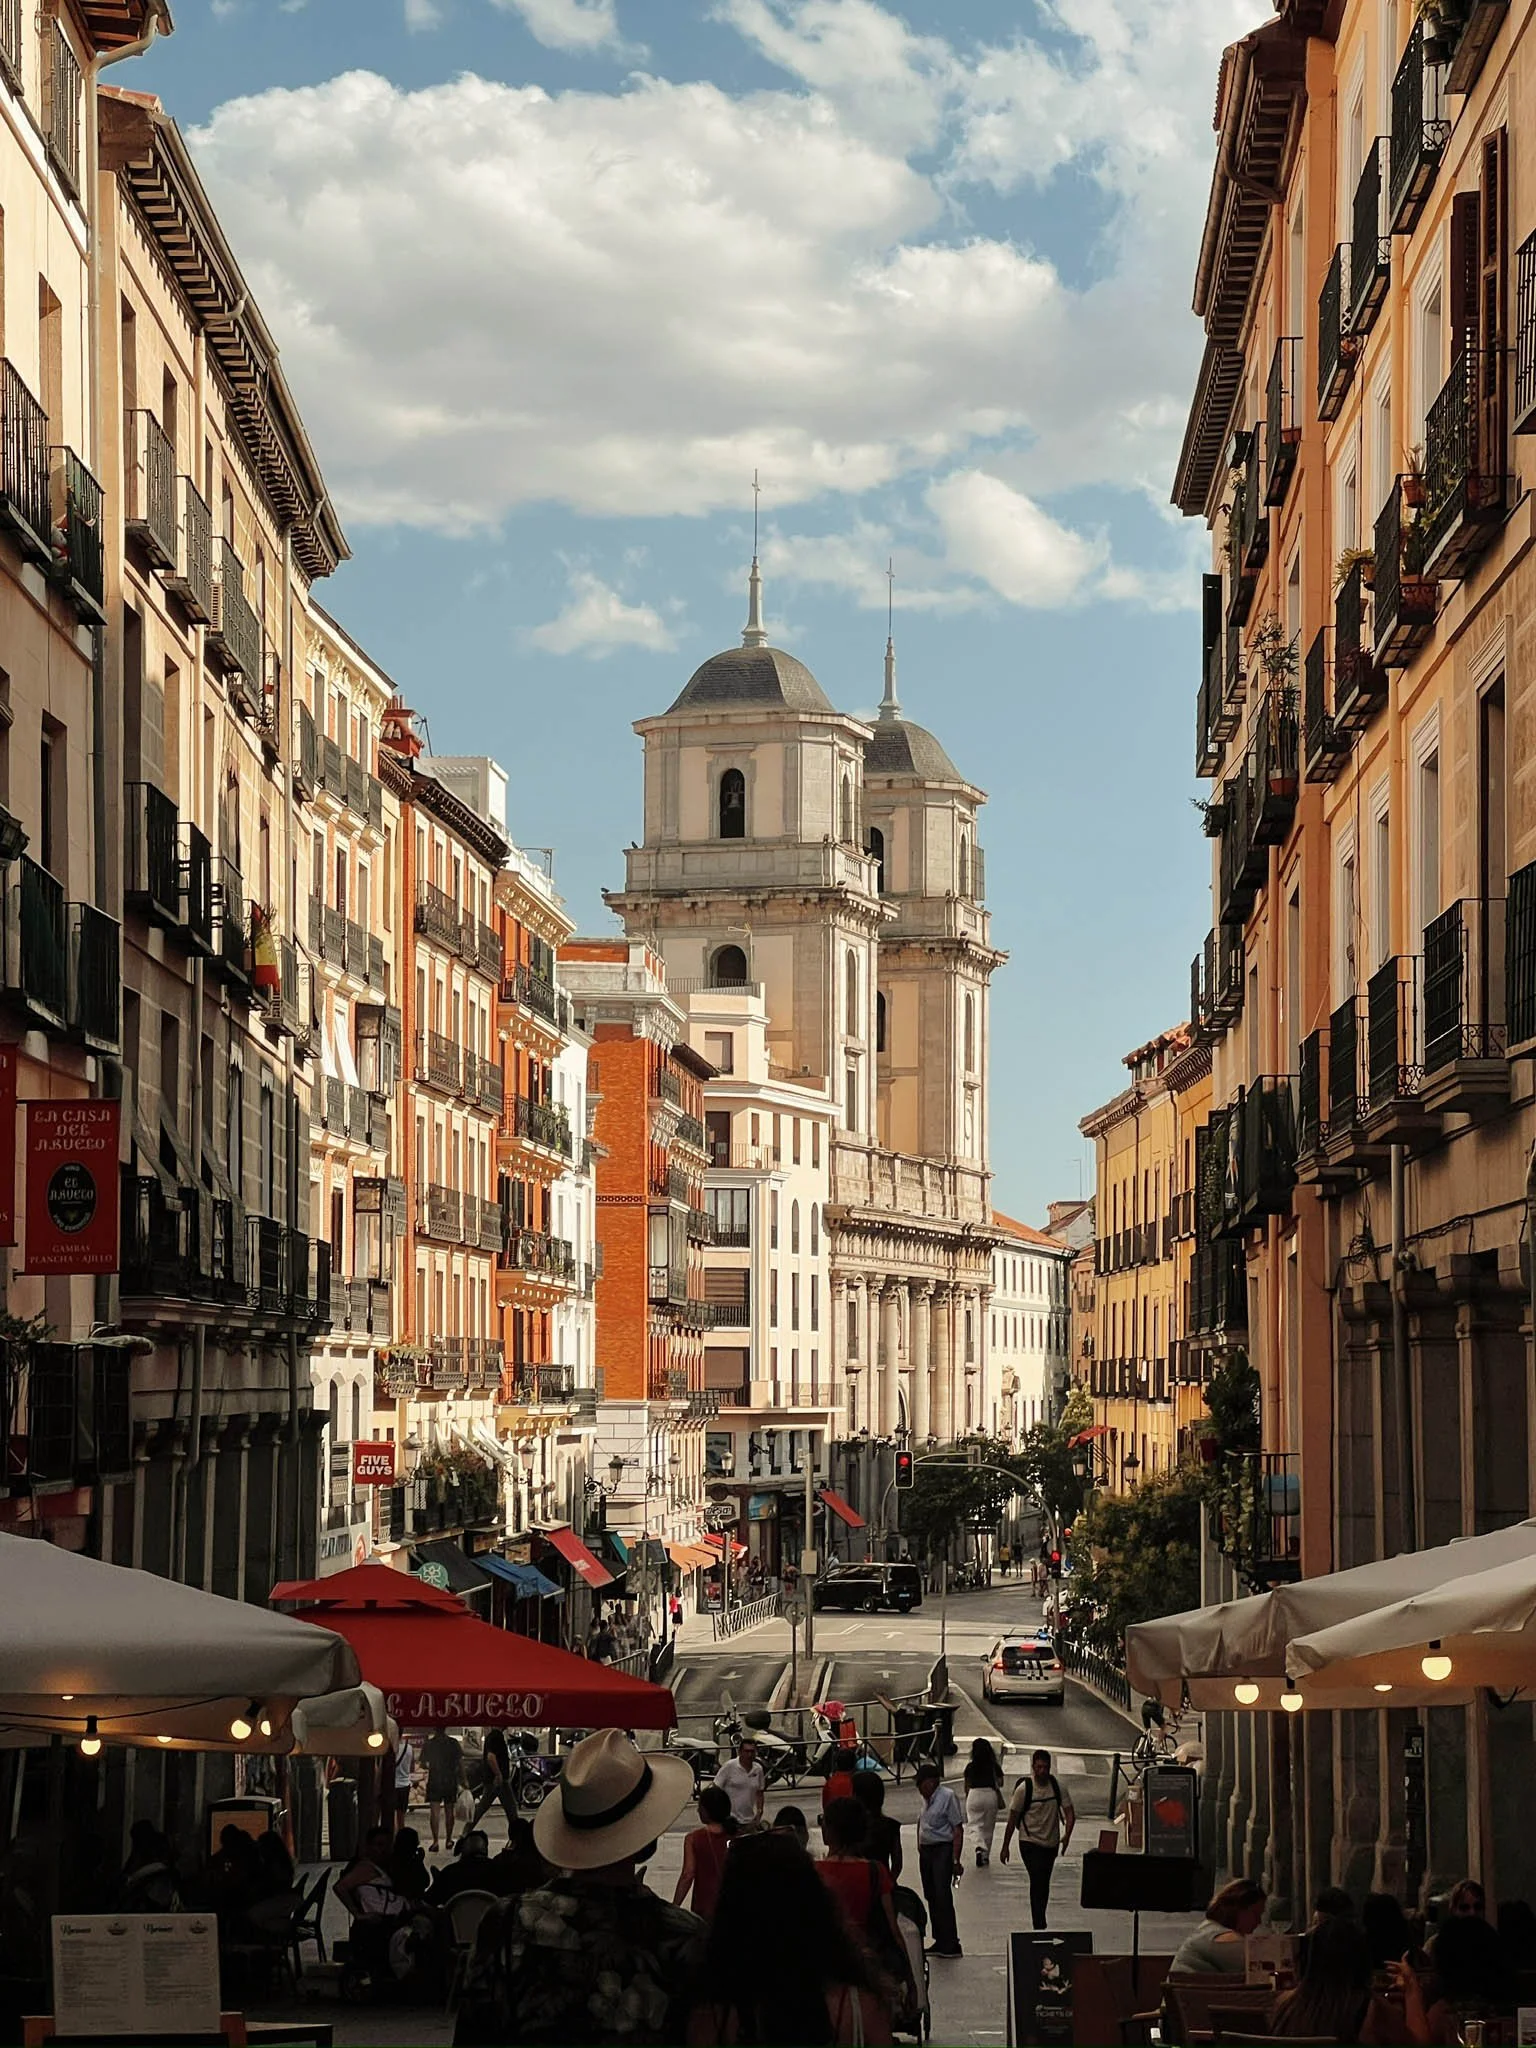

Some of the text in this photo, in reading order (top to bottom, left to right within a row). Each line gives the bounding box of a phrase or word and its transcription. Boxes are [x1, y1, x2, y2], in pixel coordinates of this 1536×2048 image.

[62, 1109, 110, 1122] CASA
[55, 1124, 90, 1137] DEL
[34, 1138, 105, 1151] ABUELO
[360, 1455, 390, 1465] FIVE
[356, 1465, 393, 1475] GUYS
[411, 1693, 543, 1719] ABUELO
